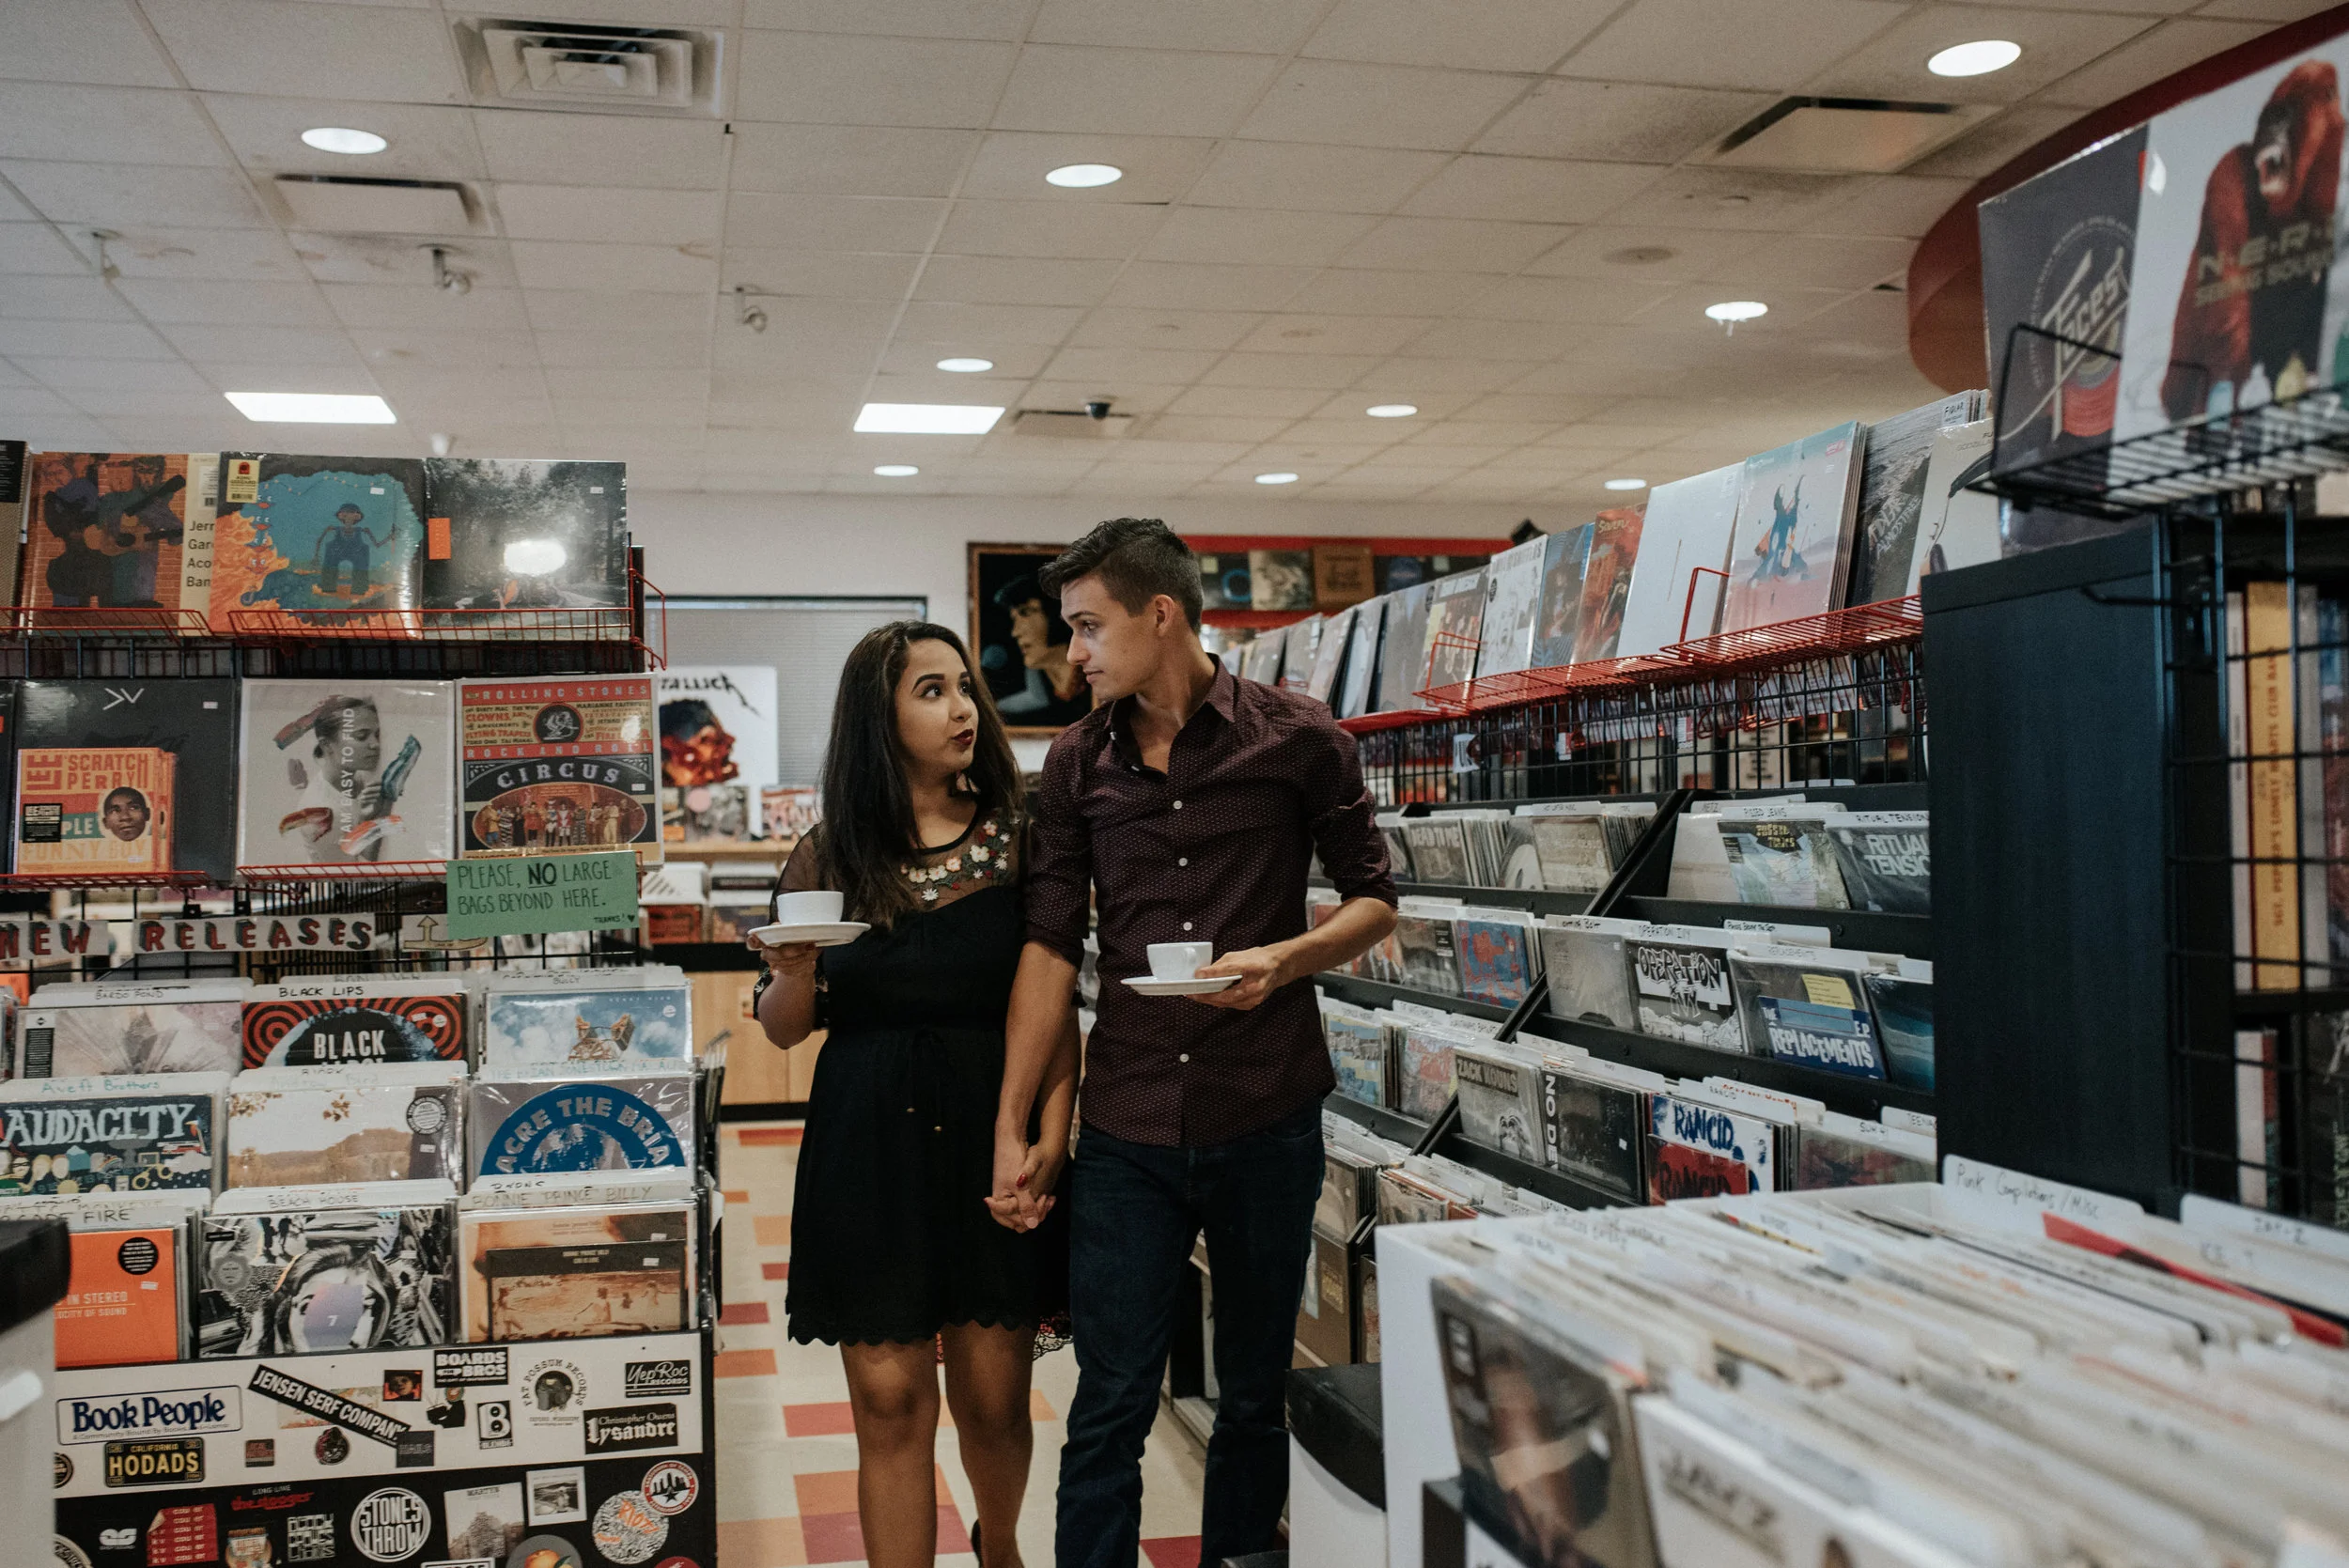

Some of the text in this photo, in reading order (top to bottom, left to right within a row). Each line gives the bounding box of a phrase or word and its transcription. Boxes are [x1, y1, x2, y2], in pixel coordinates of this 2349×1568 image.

[189, 520, 215, 532] Jerr
[188, 539, 213, 551] Gar
[187, 559, 211, 568] Aco
[186, 577, 210, 587] Ban
[483, 687, 564, 700] ROLLING
[576, 685, 647, 697] STONES
[342, 707, 356, 743] FIND
[341, 746, 354, 769] TO
[467, 747, 524, 758] ROCK
[539, 745, 580, 755] AND
[497, 762, 620, 788] CIRCUS
[341, 770, 356, 808] EASY
[340, 814, 353, 838] AM
[458, 860, 612, 889] PLEASE, NO LARGE
[458, 888, 607, 916] BAGS BEYOND HERE.
[138, 917, 372, 952] RELEASES
[1636, 946, 1722, 991] OPERATION
[278, 986, 365, 998] BLACK LIPS
[313, 1030, 386, 1060] BLACK
[1768, 1027, 1875, 1069] REPLACEMENTS
[1456, 1059, 1483, 1082] ZACK
[1546, 1074, 1557, 1118] NO
[3, 1104, 196, 1147] AUDACITY
[495, 1108, 552, 1173] ACRE
[556, 1096, 613, 1118] THE
[616, 1104, 671, 1166] BRIA
[1672, 1103, 1736, 1152] RANCID
[605, 1186, 654, 1201] BILLY
[84, 1208, 134, 1224] FIRE
[83, 1291, 129, 1304] STEREO
[328, 1315, 338, 1327] 7
[436, 1351, 507, 1367] BOARDS
[462, 1364, 507, 1377] BROS
[654, 1361, 689, 1377] Roc
[253, 1369, 306, 1404] JENSEN
[303, 1389, 342, 1415] SERF
[525, 1358, 564, 1383] POSSUM
[565, 1361, 589, 1406] RECORDS
[649, 1377, 689, 1386] RECORDS
[72, 1392, 226, 1433] Book People
[108, 1452, 199, 1477] HODADS
[360, 1496, 423, 1527] STONES
[361, 1522, 422, 1555] THROW
